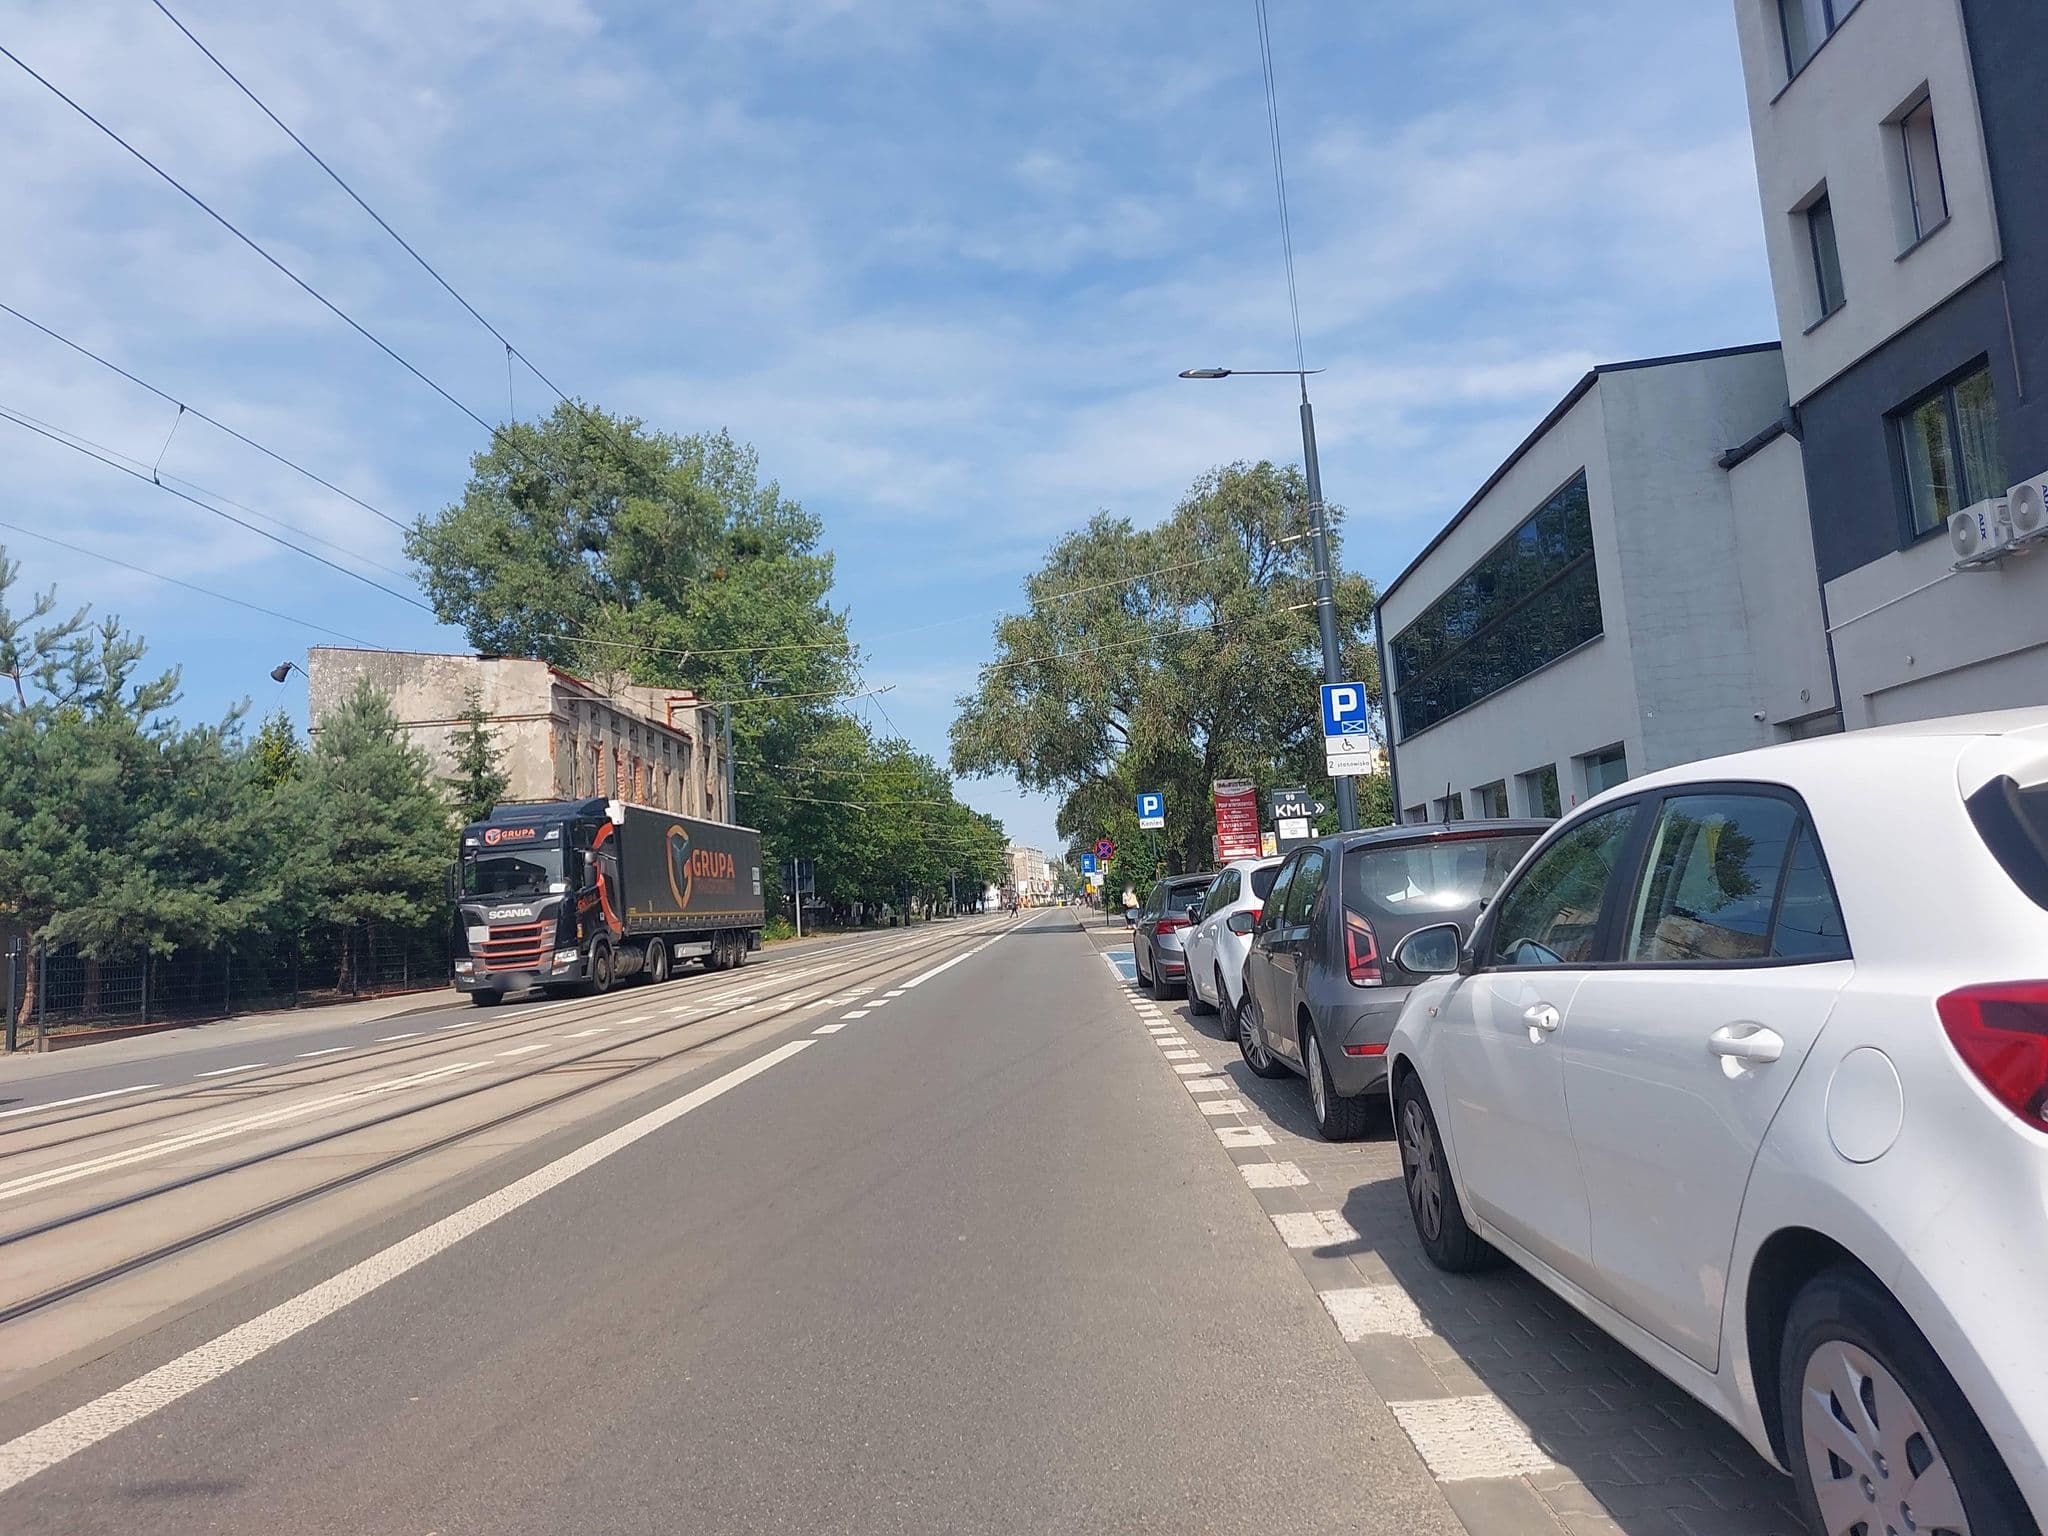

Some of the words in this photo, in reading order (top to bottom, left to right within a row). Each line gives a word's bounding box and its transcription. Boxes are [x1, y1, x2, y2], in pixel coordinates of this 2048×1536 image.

[1978, 513, 1987, 540] AUX
[1331, 688, 1357, 721] P
[1329, 760, 1334, 769] 2
[1143, 796, 1158, 816] P
[1275, 803, 1312, 817] KML
[501, 828, 535, 838] GRUPA
[692, 849, 735, 879] GRUPA
[488, 908, 532, 919] SCANIA
